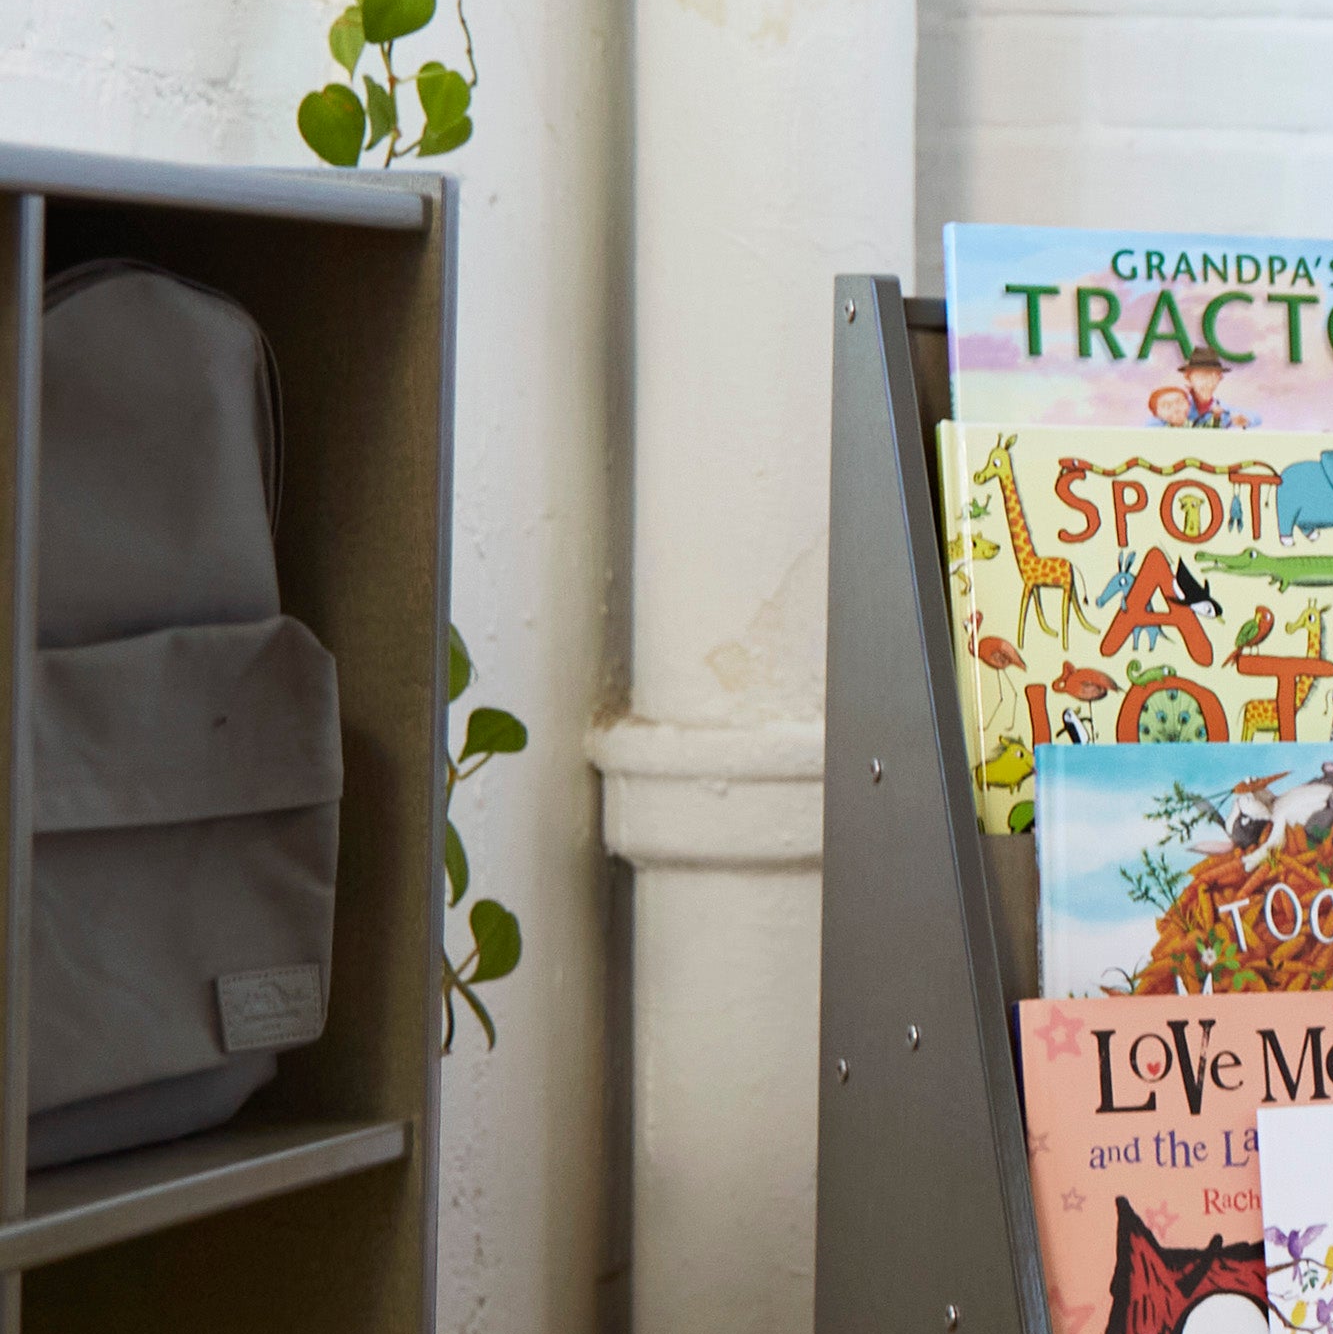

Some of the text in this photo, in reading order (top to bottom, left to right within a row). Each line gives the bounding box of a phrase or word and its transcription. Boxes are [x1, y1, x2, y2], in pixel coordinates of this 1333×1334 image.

[1055, 469, 1281, 547] SPOT
[1101, 546, 1213, 667] A
[1090, 1137, 1141, 1169] and
[1153, 1130, 1209, 1168] the
